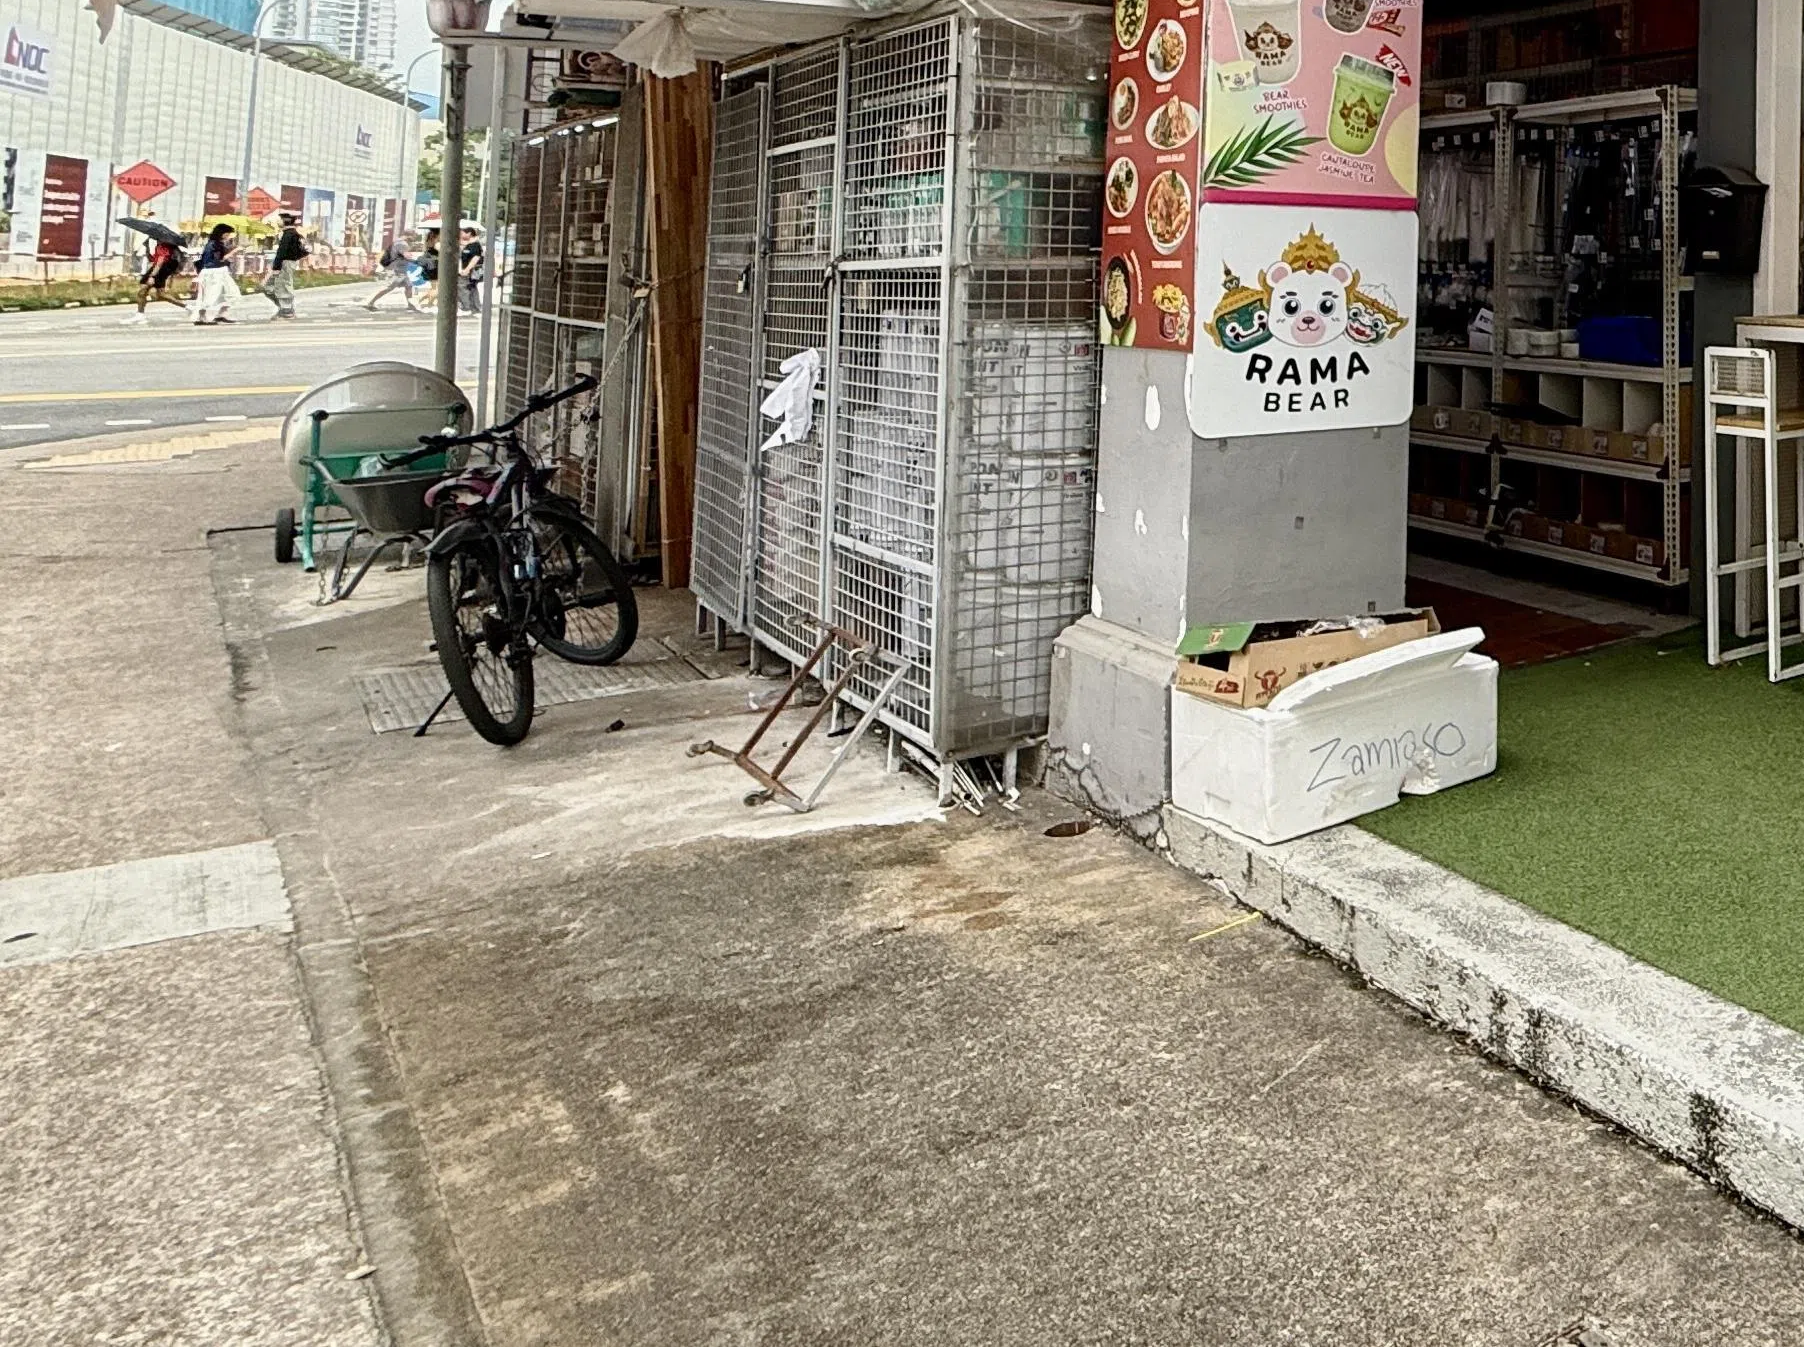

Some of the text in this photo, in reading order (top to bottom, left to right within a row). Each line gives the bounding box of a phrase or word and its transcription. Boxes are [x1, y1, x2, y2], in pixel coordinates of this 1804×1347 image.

[1255, 50, 1287, 59] RAMA
[1381, 52, 1408, 79] NEW
[1262, 90, 1290, 102] BEAR
[1254, 100, 1307, 114] SMOOTHIES
[117, 176, 168, 188] CAUTION
[1358, 173, 1374, 183] TEA
[1245, 352, 1370, 385] RAMA
[1264, 389, 1349, 413] BEAR
